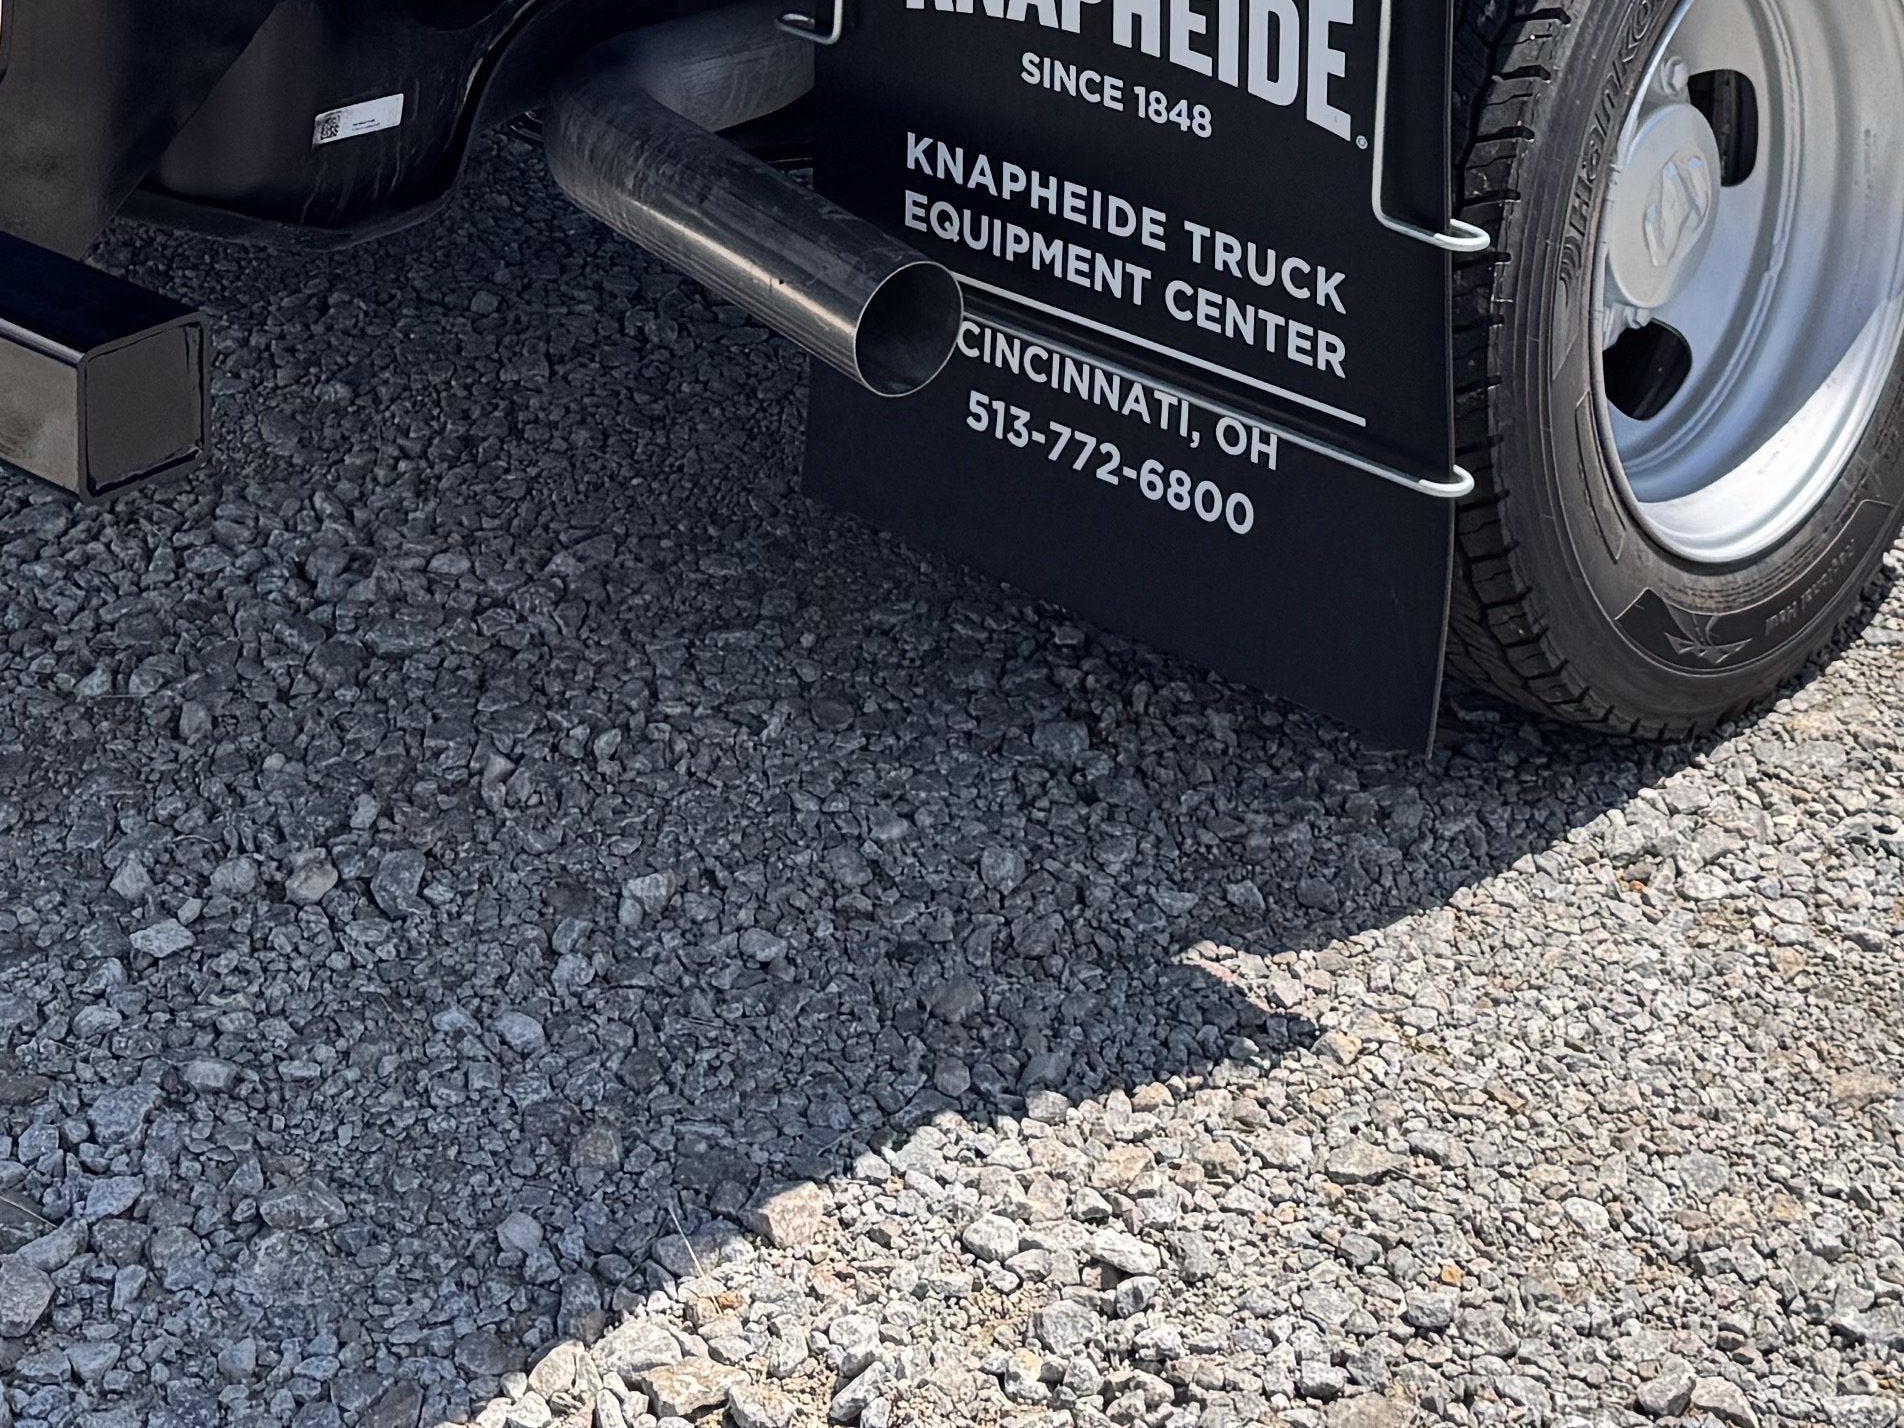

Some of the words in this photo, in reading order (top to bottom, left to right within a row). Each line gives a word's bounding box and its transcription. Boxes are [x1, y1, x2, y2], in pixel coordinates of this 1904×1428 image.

[1020, 51, 1124, 112] SINCE
[1132, 85, 1213, 139] 1848
[904, 189, 1152, 306] EQUIPMENT
[1164, 280, 1347, 379] CENTER
[906, 131, 1167, 252] KNAPHEIDE
[1184, 220, 1348, 315] TRUCK
[956, 320, 1200, 449] CINCINNATI,
[1215, 416, 1279, 471] OH
[965, 389, 1255, 535] 513-772-6800
